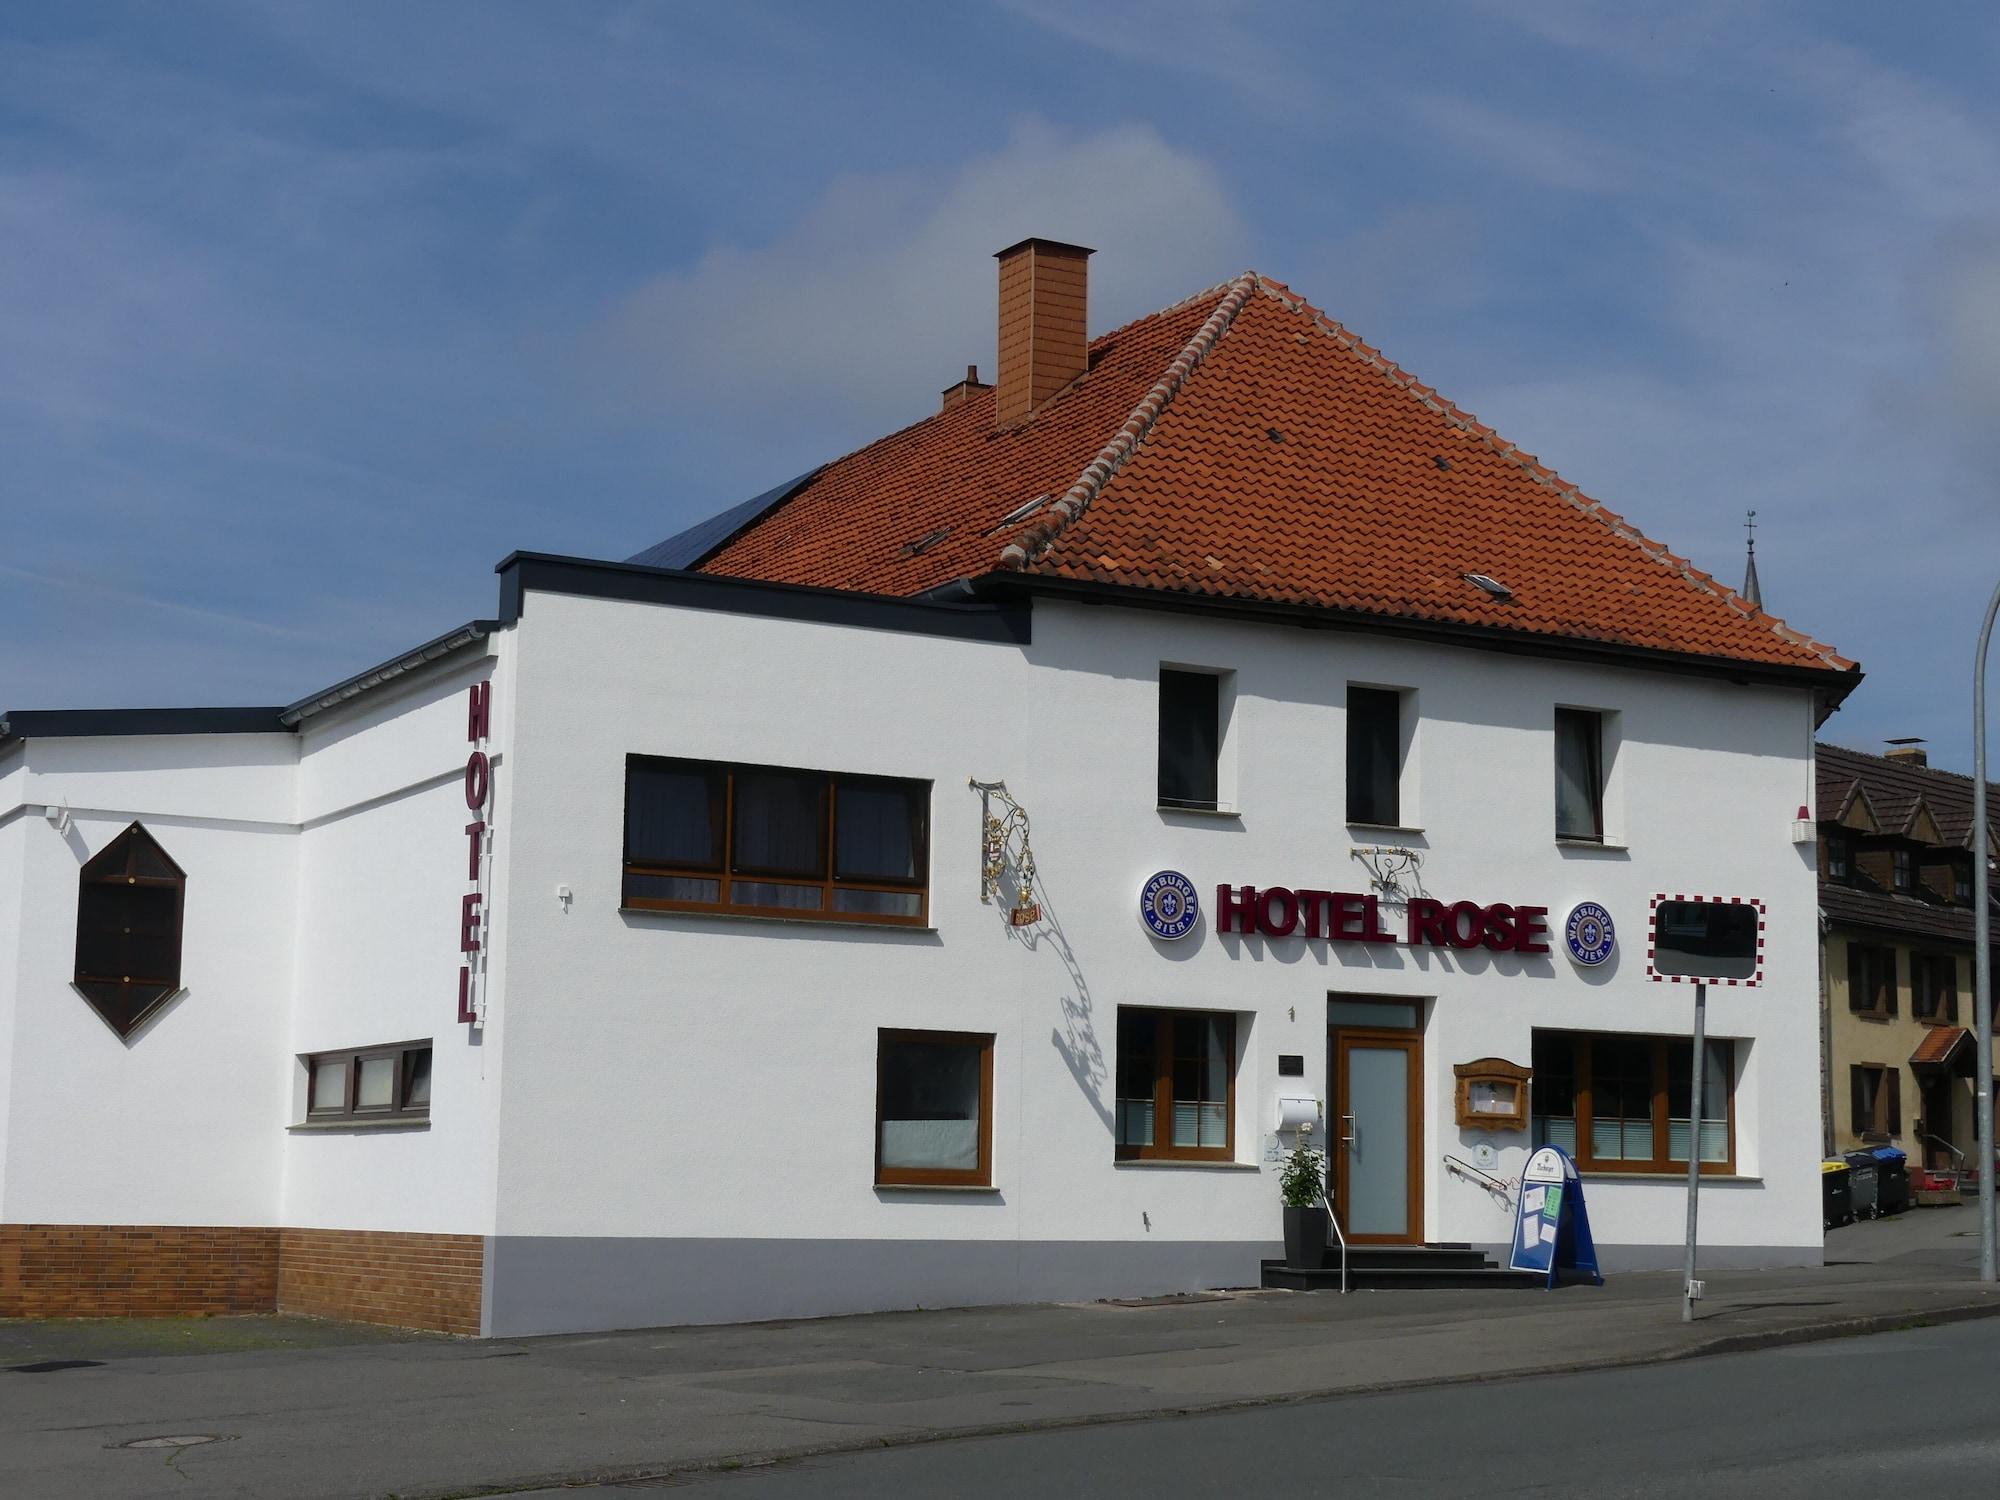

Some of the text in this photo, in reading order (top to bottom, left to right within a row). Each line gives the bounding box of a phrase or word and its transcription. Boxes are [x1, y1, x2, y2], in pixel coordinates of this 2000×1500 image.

[458, 680, 490, 1023] HOTEL
[1145, 875, 1195, 914] WARBURGER
[1154, 919, 1186, 934] BIER
[1216, 884, 1549, 953] HOTEL ROSE
[1568, 906, 1612, 942] WARBURGER
[1577, 947, 1605, 960] BIER
